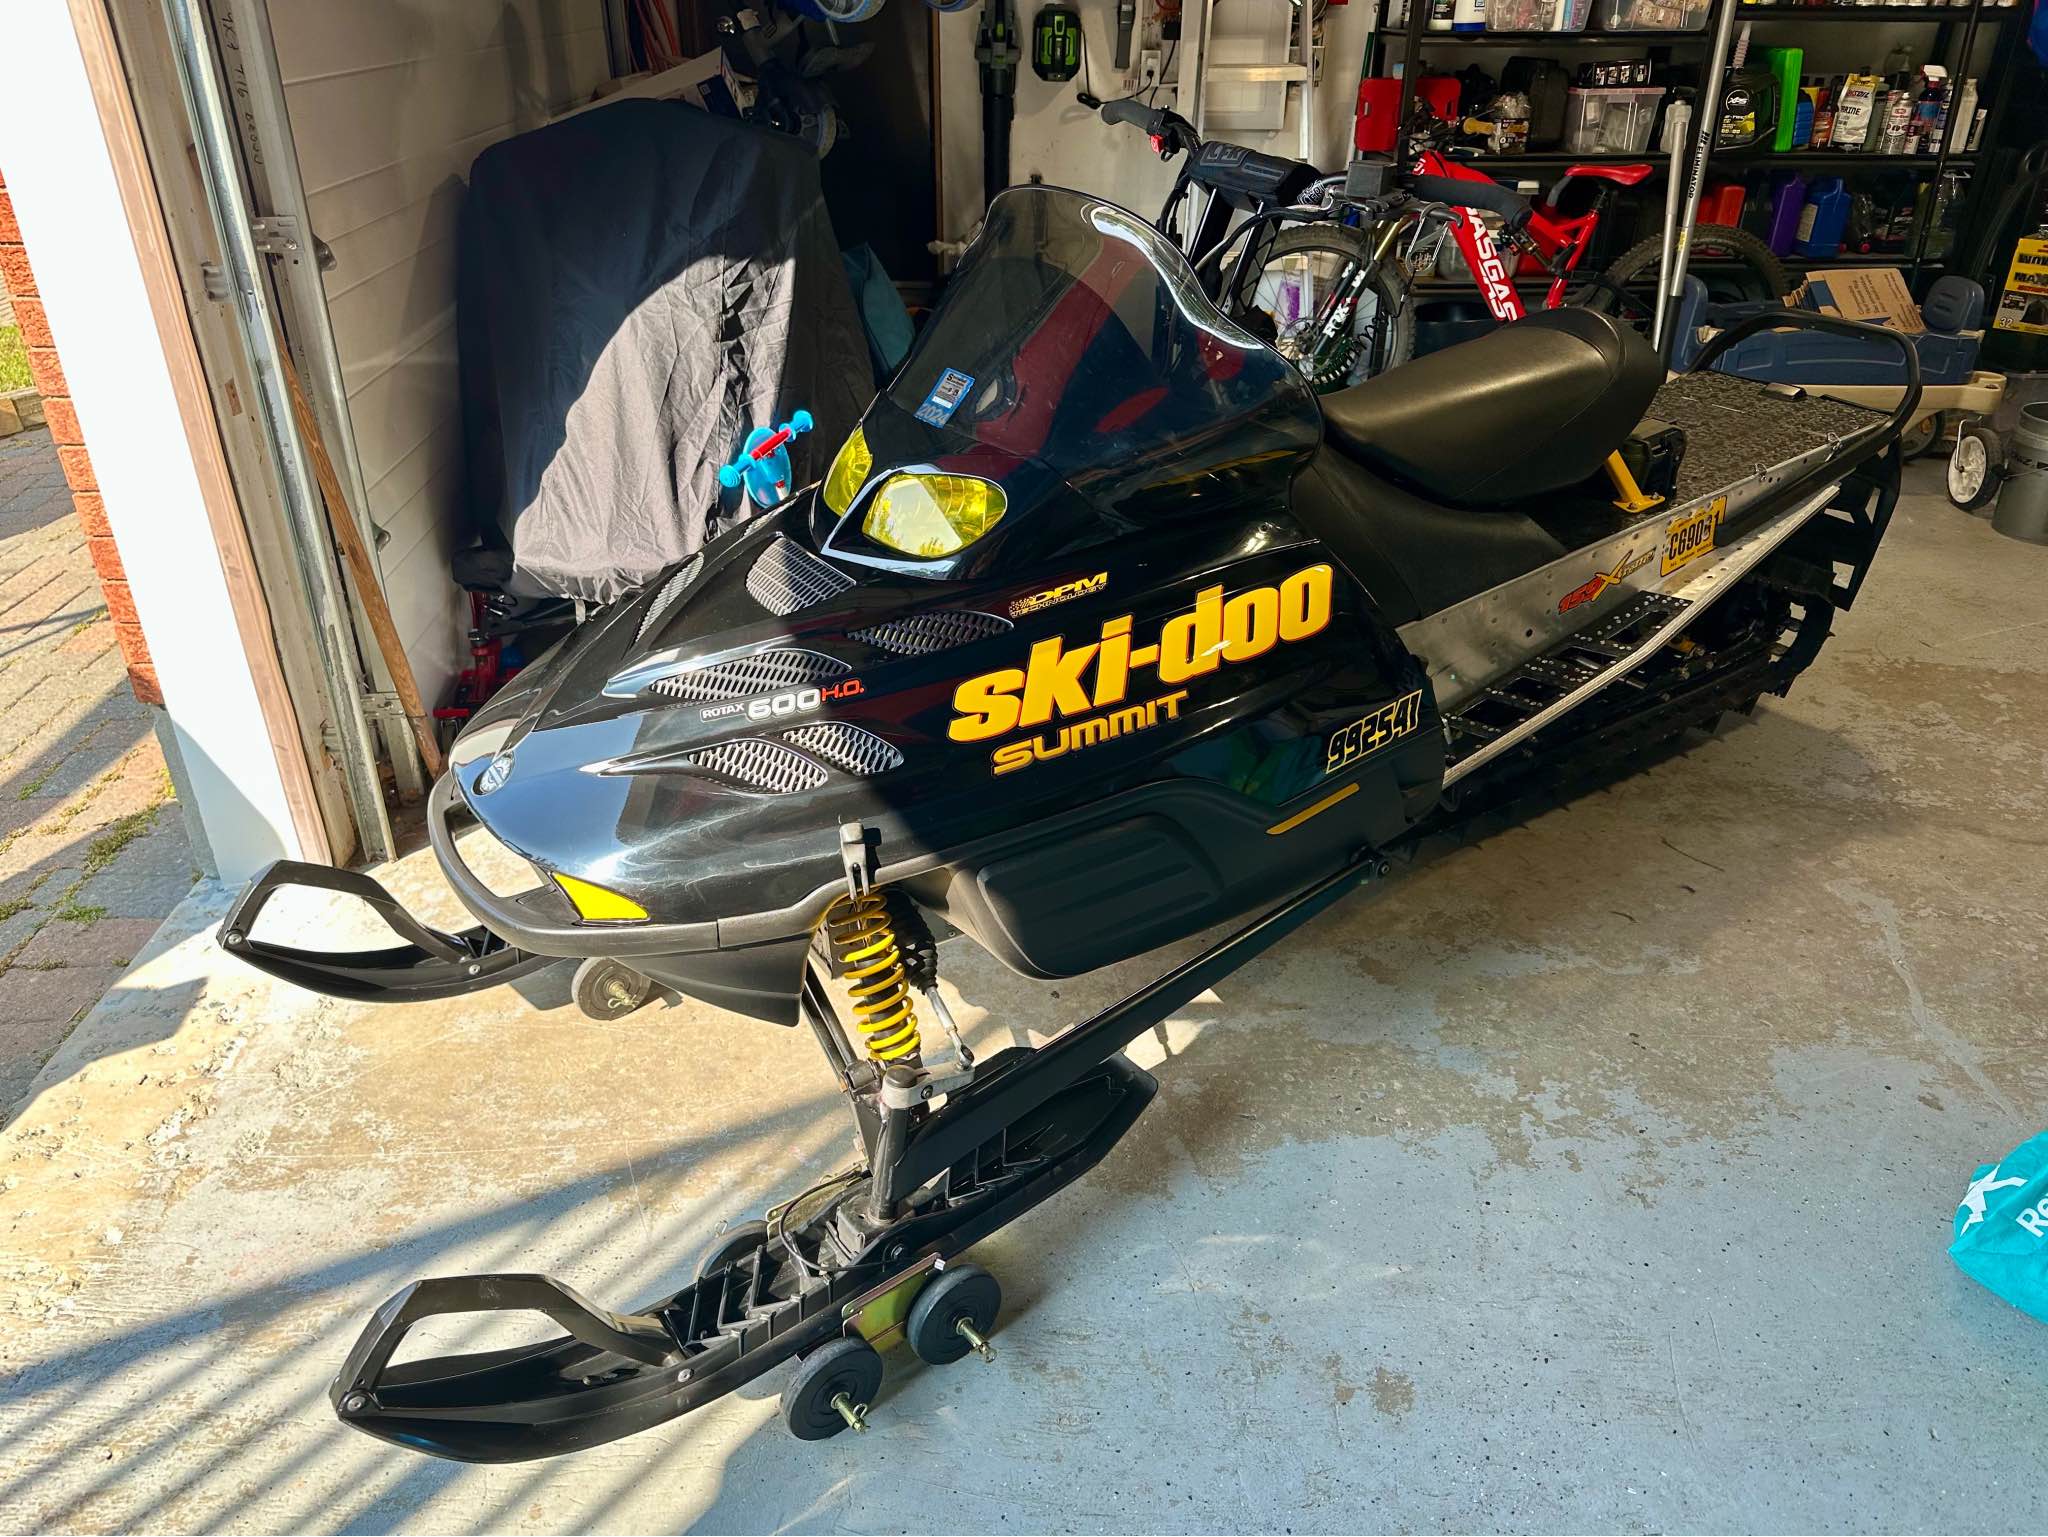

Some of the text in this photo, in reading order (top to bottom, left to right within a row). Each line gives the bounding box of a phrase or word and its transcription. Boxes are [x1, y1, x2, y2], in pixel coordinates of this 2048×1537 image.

[1688, 145, 1704, 199] ELIMINATOR
[1028, 571, 1108, 605] DPM
[702, 679, 865, 720] ROTAX 600 H.O.
[991, 689, 1190, 777] SUMMIT
[1326, 689, 1423, 774] 992541
[2015, 1194, 2048, 1238] Re
